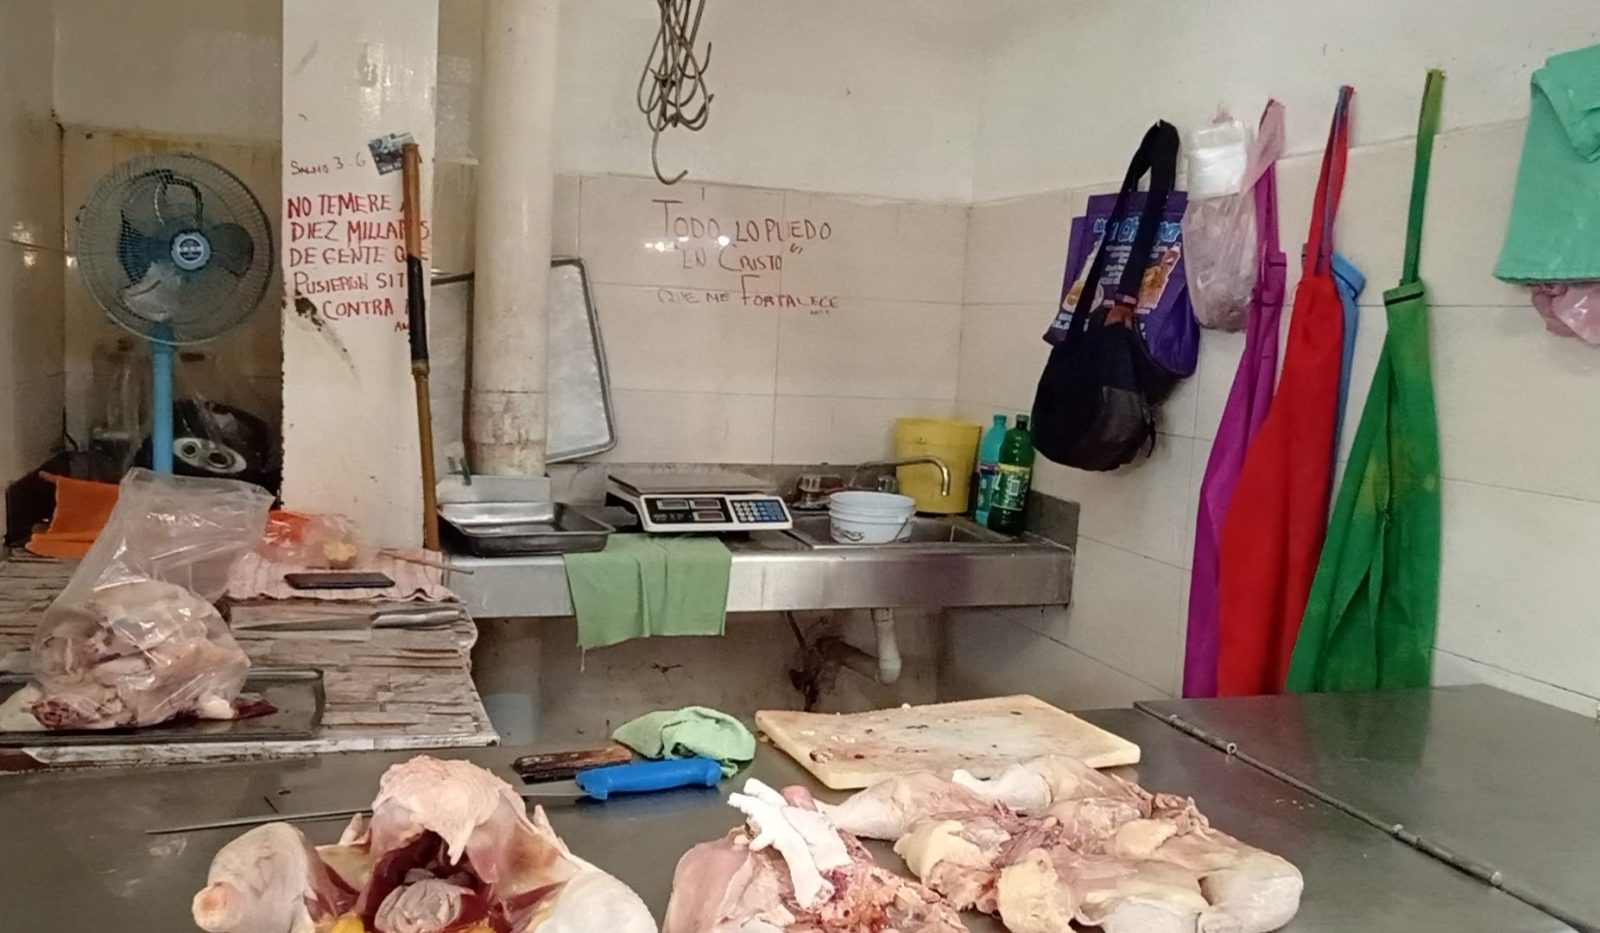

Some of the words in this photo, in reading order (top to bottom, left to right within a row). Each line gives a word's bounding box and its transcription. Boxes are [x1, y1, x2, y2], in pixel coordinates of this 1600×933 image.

[333, 156, 344, 170] 3
[287, 196, 312, 219] NO
[318, 192, 392, 216] TEMERE
[291, 220, 339, 242] DIEZ
[347, 219, 430, 243] MILLAS
[651, 198, 720, 239] TODO
[735, 220, 760, 242] LO
[765, 218, 832, 242] PUEDO
[290, 247, 317, 267] DE
[322, 246, 385, 265] GENTE
[294, 272, 369, 294] PUSIERON
[323, 298, 394, 320] CONTRA
